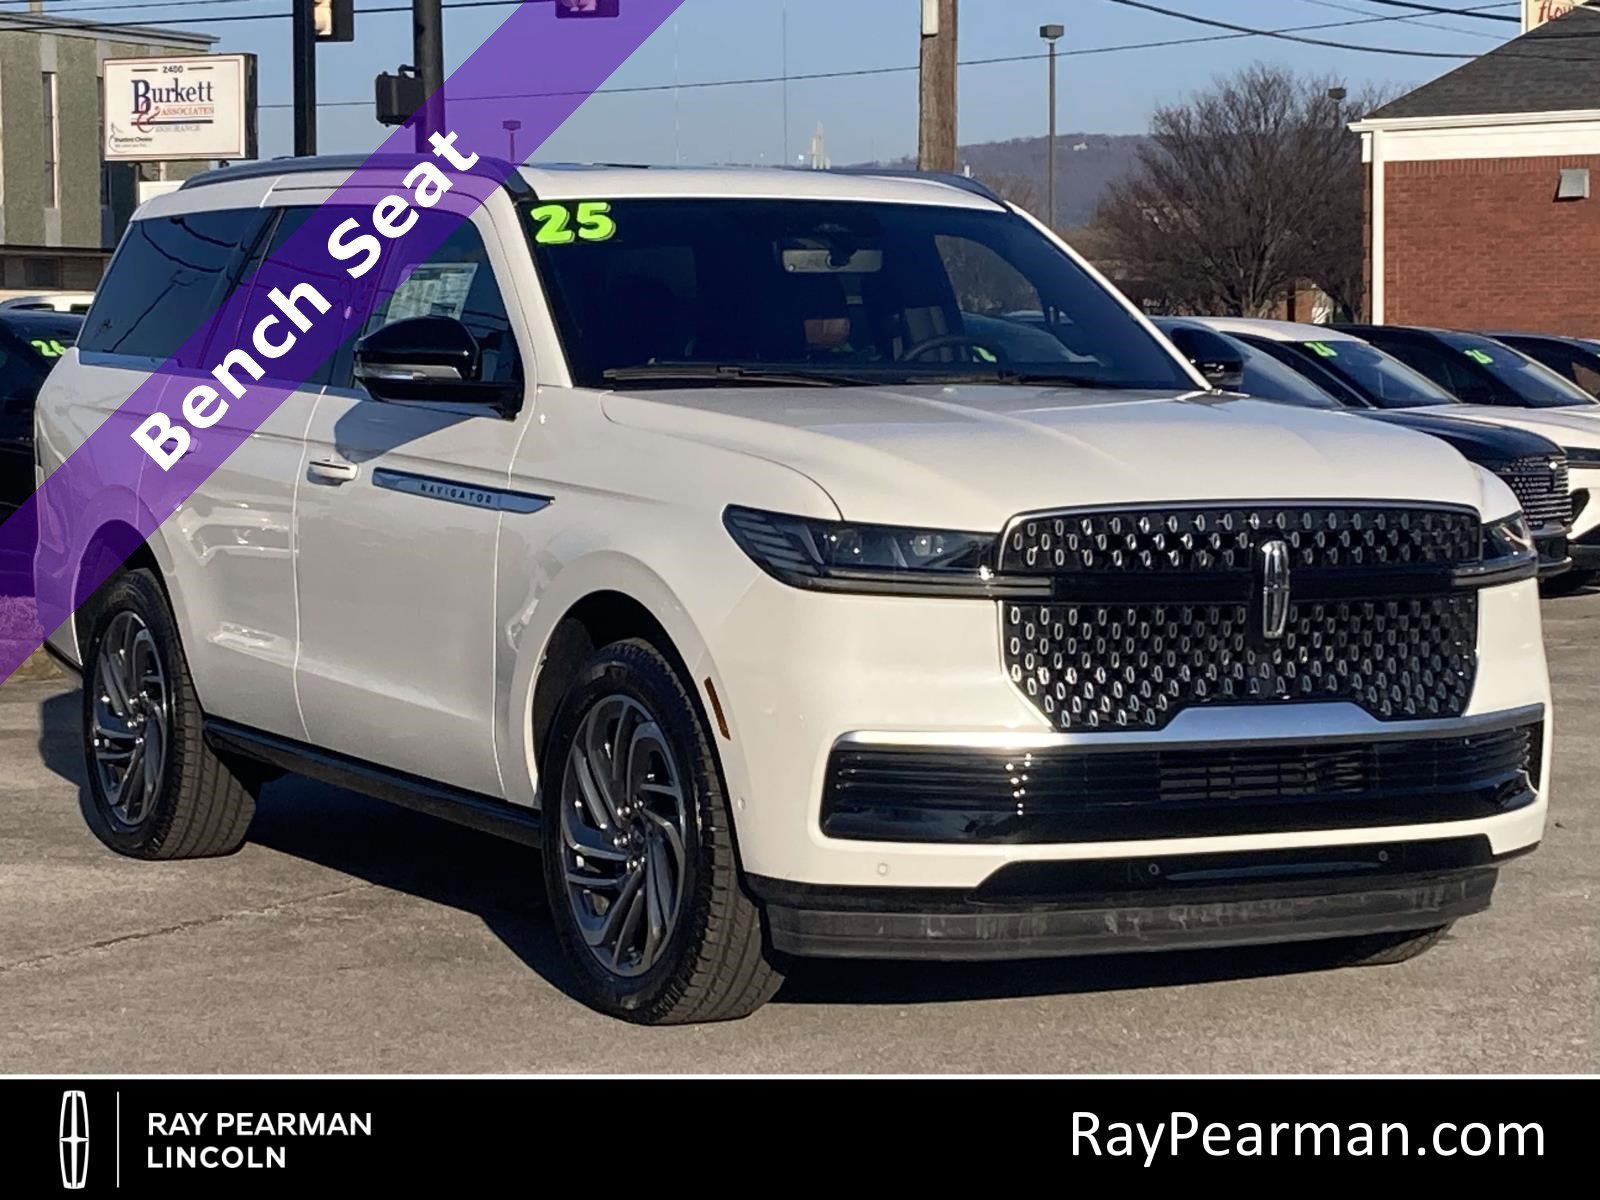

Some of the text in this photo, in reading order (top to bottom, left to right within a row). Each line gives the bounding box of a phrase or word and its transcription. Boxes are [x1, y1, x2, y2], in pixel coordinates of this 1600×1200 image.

[162, 65, 184, 74] 2400
[131, 77, 214, 114] Burkett
[530, 202, 616, 244] 25
[420, 483, 492, 504] NAVIGATOR
